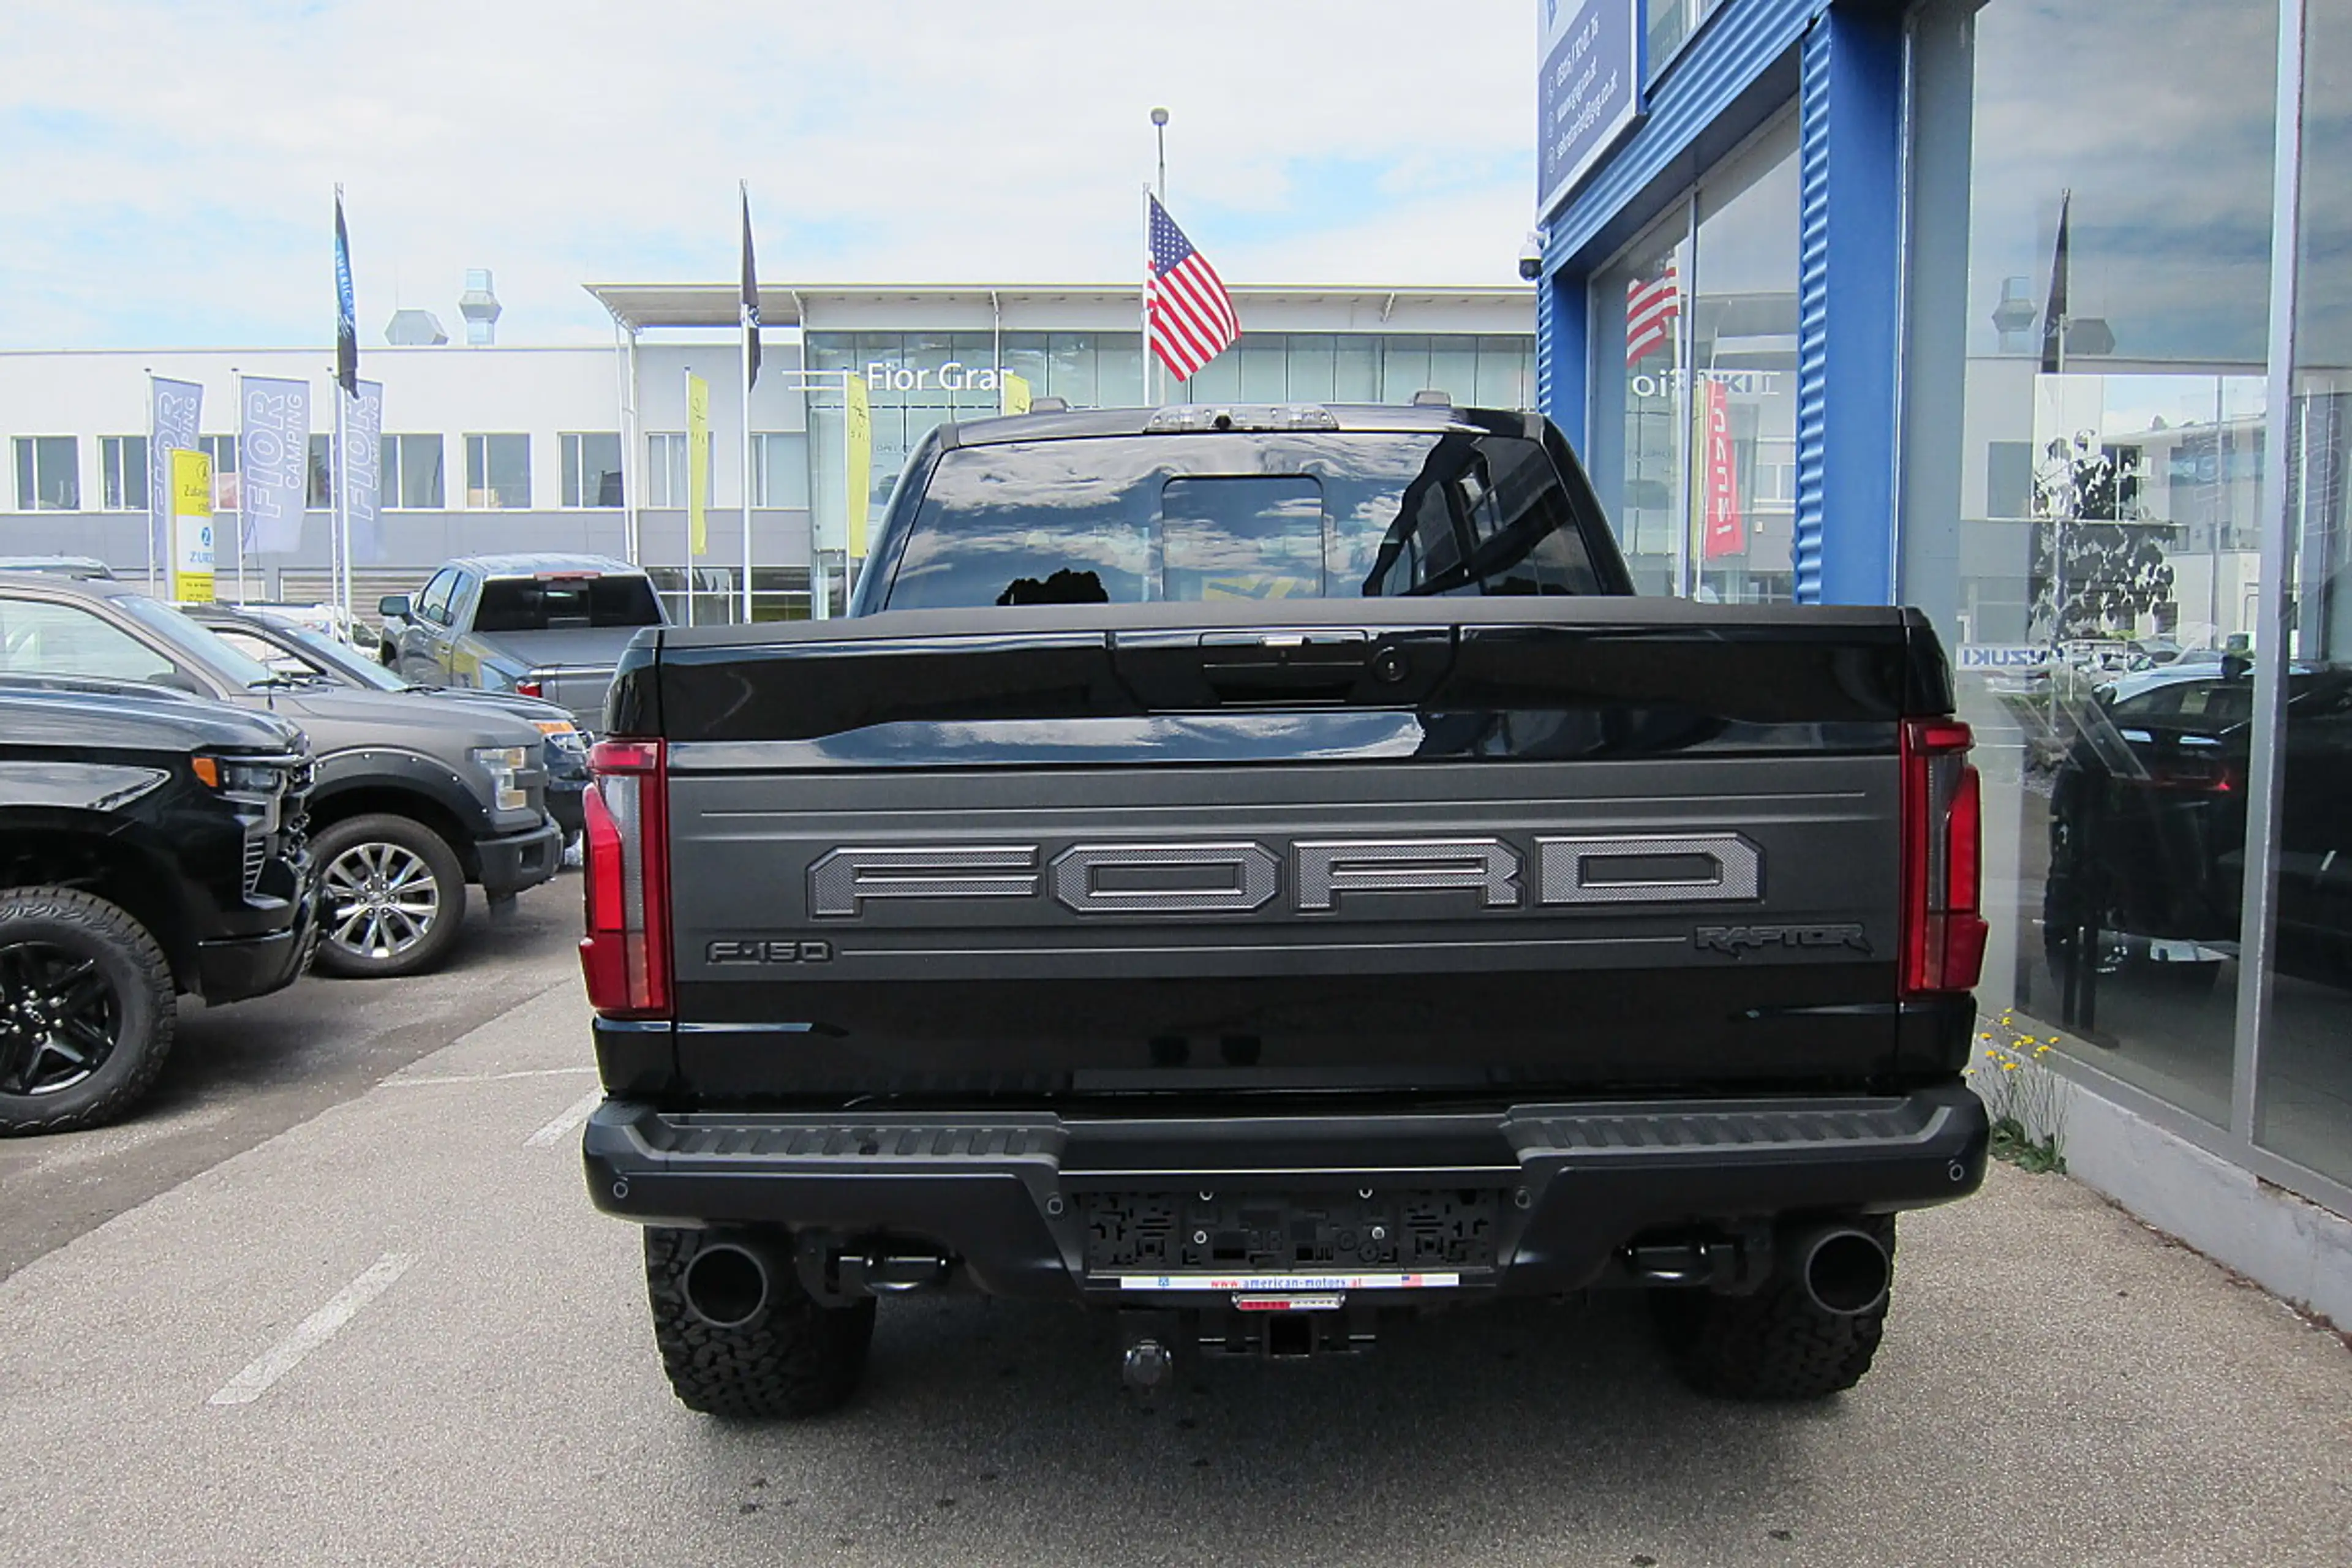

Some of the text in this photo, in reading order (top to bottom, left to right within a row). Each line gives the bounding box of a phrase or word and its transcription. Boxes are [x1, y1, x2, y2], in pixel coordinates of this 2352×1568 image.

[868, 362, 1014, 391] Fior Gra
[247, 390, 284, 519] FIOR
[285, 394, 303, 489] CAMPING
[807, 831, 1764, 918] FORD
[707, 941, 834, 963] F-150
[1695, 924, 1874, 960] RAPTOR
[1211, 1277, 1361, 1289] www.american-motors.at
